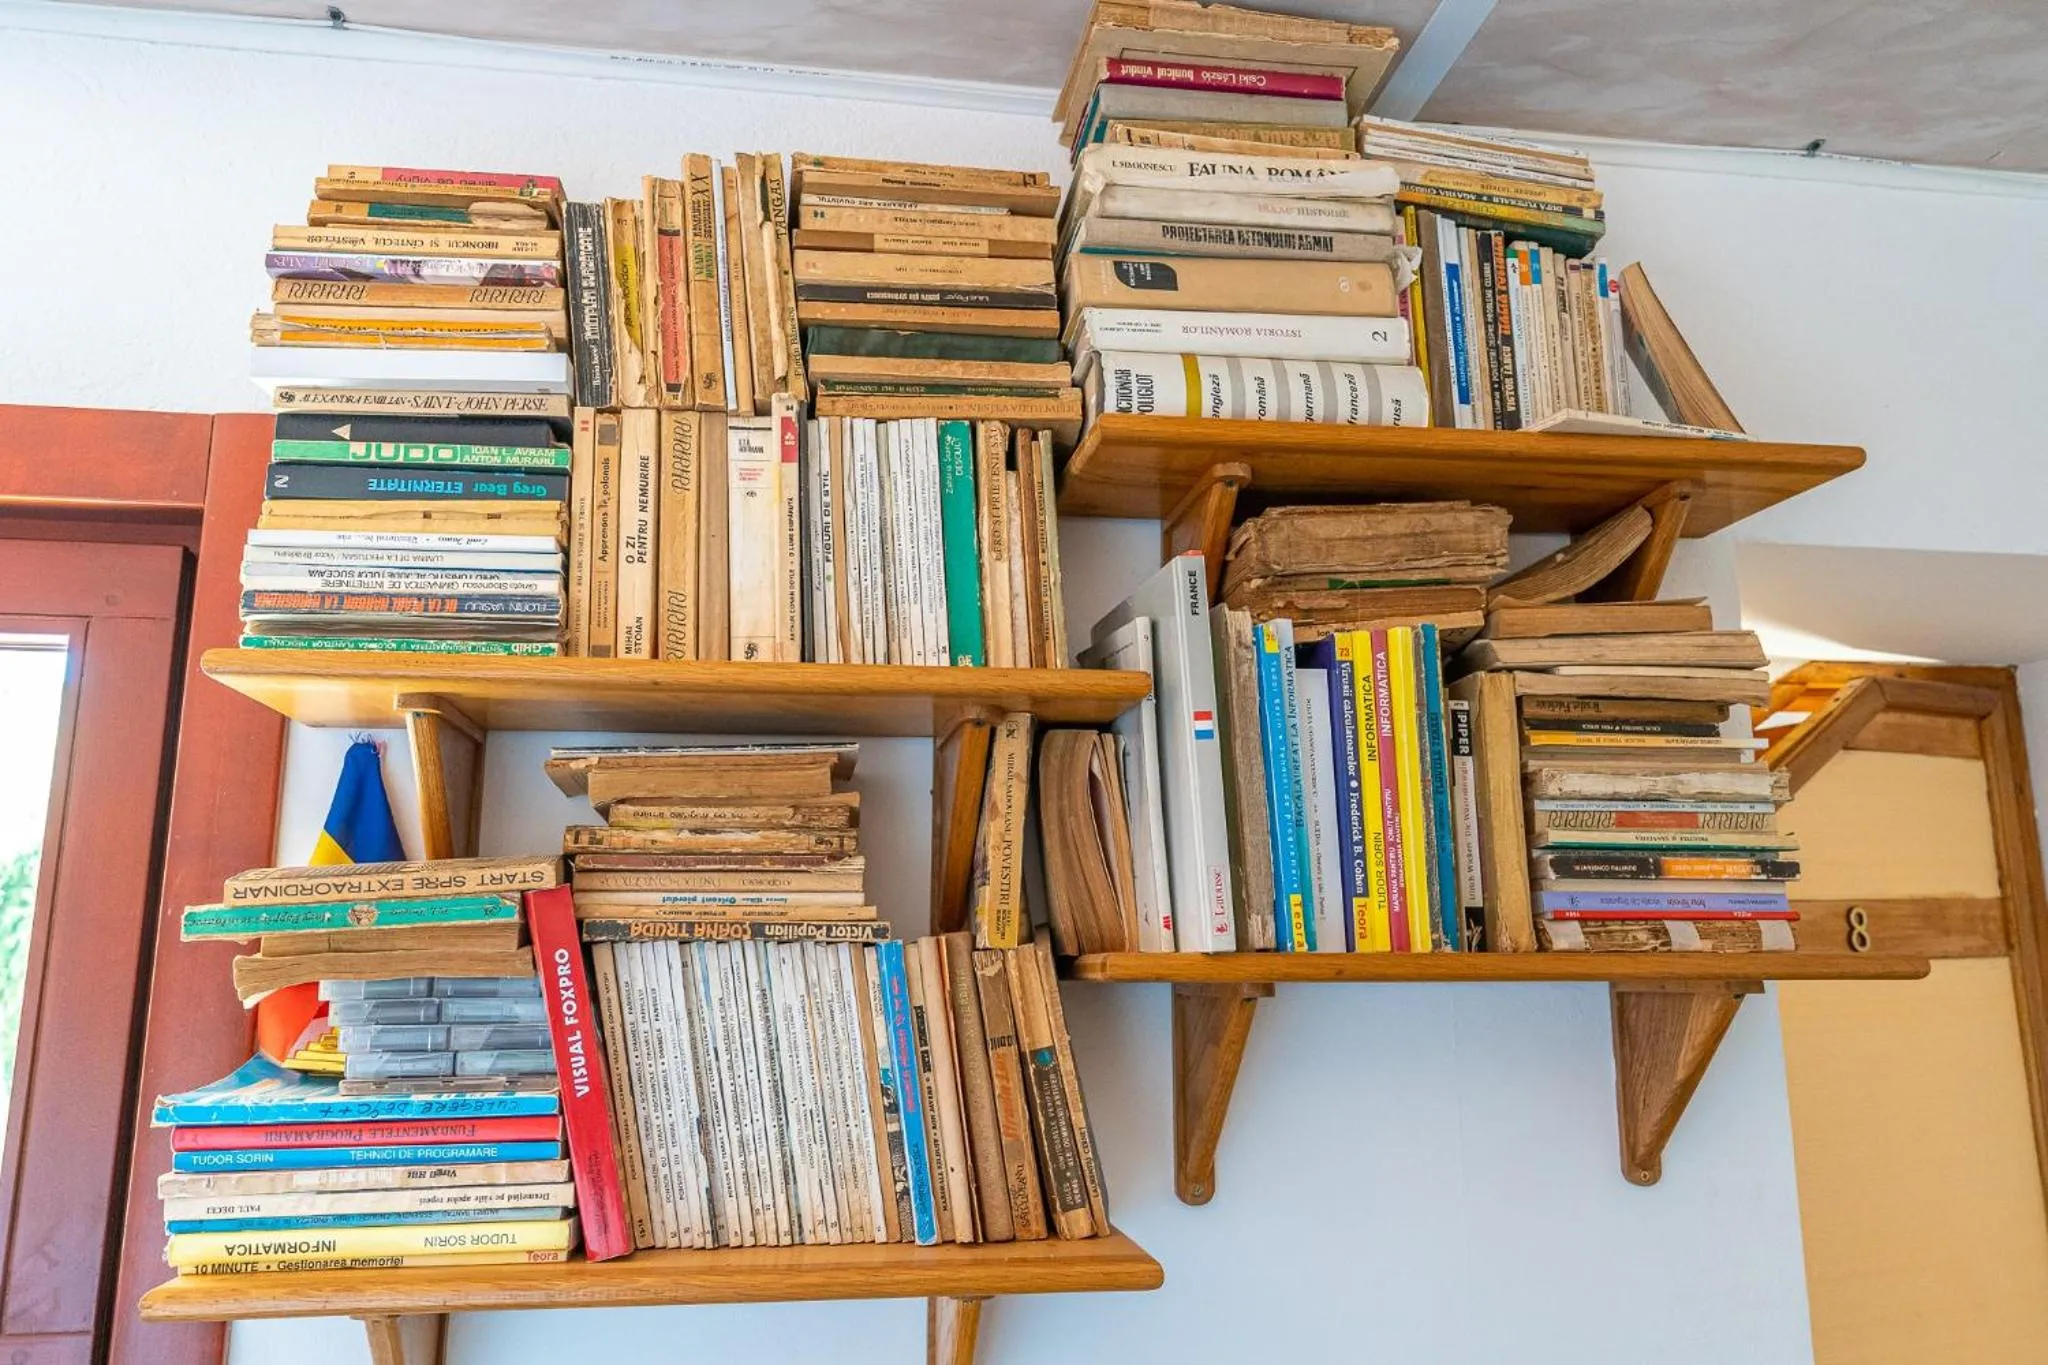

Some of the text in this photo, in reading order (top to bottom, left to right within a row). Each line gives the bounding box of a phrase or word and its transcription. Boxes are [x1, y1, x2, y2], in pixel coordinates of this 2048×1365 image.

[1371, 329, 1389, 344] 2
[351, 442, 462, 464] JUDO
[368, 478, 463, 494] ETERNITATE
[513, 482, 548, 498] Greg
[820, 470, 830, 497] STIL
[637, 455, 650, 564] PENTRU NEMURIRE
[822, 501, 831, 517] DE
[625, 535, 637, 564] O ZI
[1188, 570, 1200, 616] FRANCE
[624, 626, 634, 656] MIHAI
[1375, 651, 1391, 737] INFORMATICA
[1361, 674, 1377, 762] INFORMATICA
[1343, 699, 1358, 777] calculatoarelor
[1457, 714, 1469, 755] PIPER
[1348, 792, 1364, 843] Frederick
[232, 870, 545, 899] START SPRE EXTRAORDINAR
[1354, 859, 1367, 894] Cohen
[1373, 832, 1388, 911] TUDOR SORIN
[628, 921, 690, 938] TRUDA
[764, 922, 828, 939] Papilian
[829, 924, 872, 940] Victor
[1356, 903, 1368, 940] Teora
[1846, 905, 1870, 953] 8
[554, 948, 590, 1098] VISUAL FOXPRO
[368, 1123, 477, 1139] FUNDAMENTELE
[193, 1154, 234, 1166] TUDOR
[236, 1152, 274, 1165] SORIN
[399, 1147, 418, 1160] DE
[420, 1145, 498, 1159] PROGRAMARE
[225, 1232, 517, 1256] TUDOR SORIN INFORMATICA
[527, 1250, 559, 1261] Teora
[193, 1264, 208, 1275] 10
[211, 1261, 259, 1273] MINUTE
[277, 1258, 347, 1272] Gestionarea
